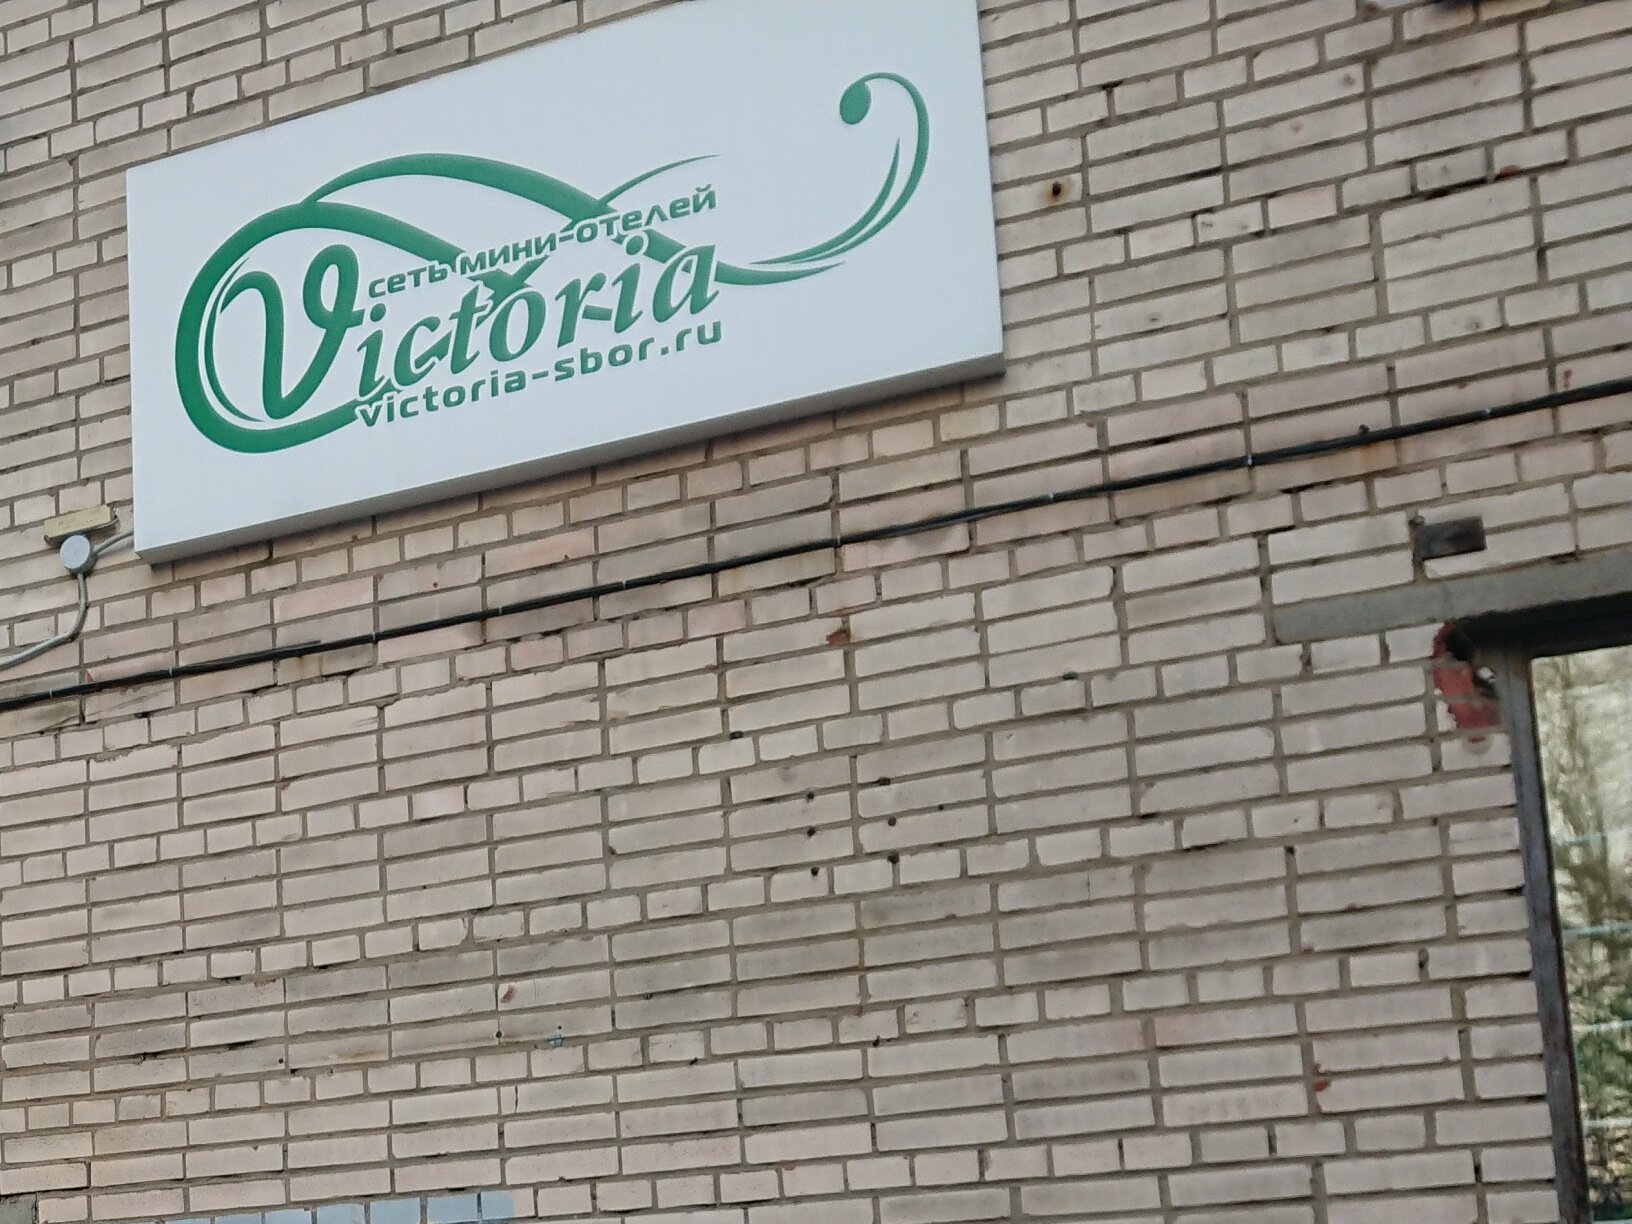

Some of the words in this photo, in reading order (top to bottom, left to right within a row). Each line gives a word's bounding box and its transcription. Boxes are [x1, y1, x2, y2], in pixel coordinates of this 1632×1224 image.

[368, 260, 449, 299] сеть
[459, 184, 718, 276] мини-отелей
[204, 236, 720, 420] Victoria
[359, 320, 722, 428] victoria-sbor.ru
